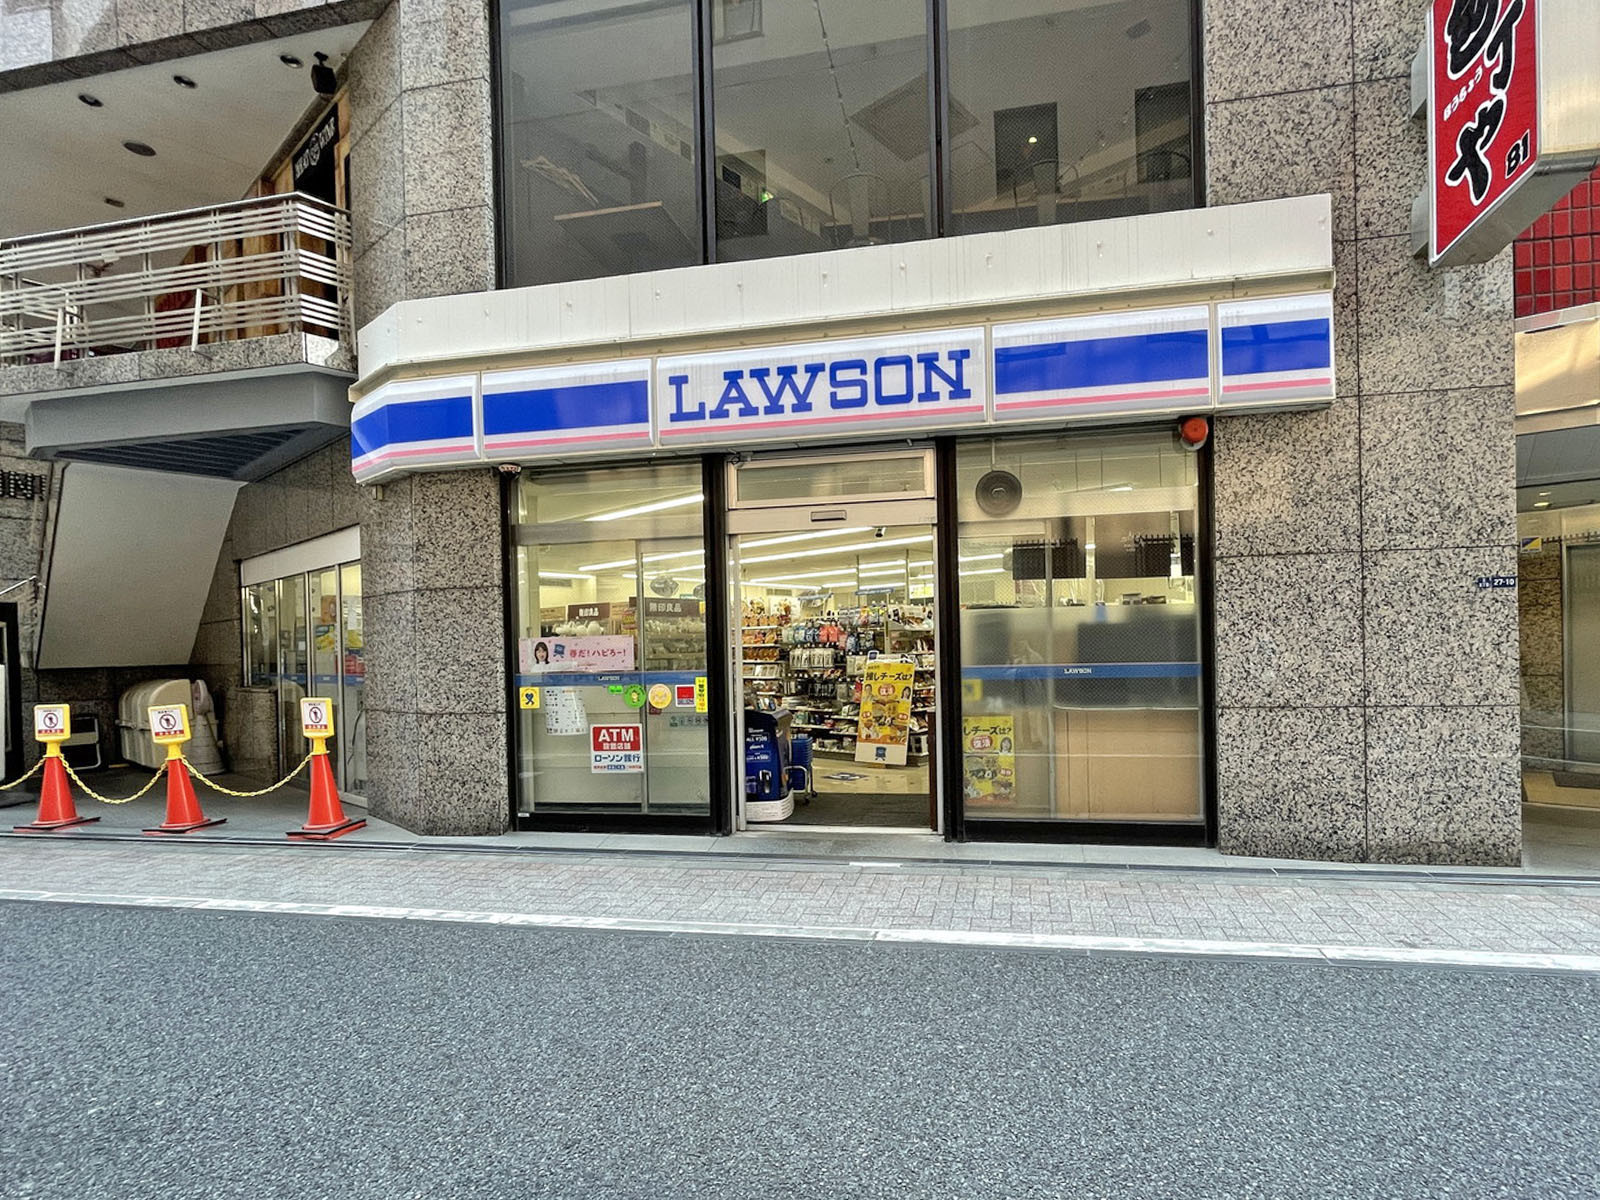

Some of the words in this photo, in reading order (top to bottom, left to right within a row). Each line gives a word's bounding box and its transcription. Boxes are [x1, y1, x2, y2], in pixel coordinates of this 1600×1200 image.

[1505, 130, 1530, 178] 81
[669, 349, 972, 423] LAWSON
[598, 728, 634, 742] ATM
[594, 754, 641, 763] ローソン銀行
